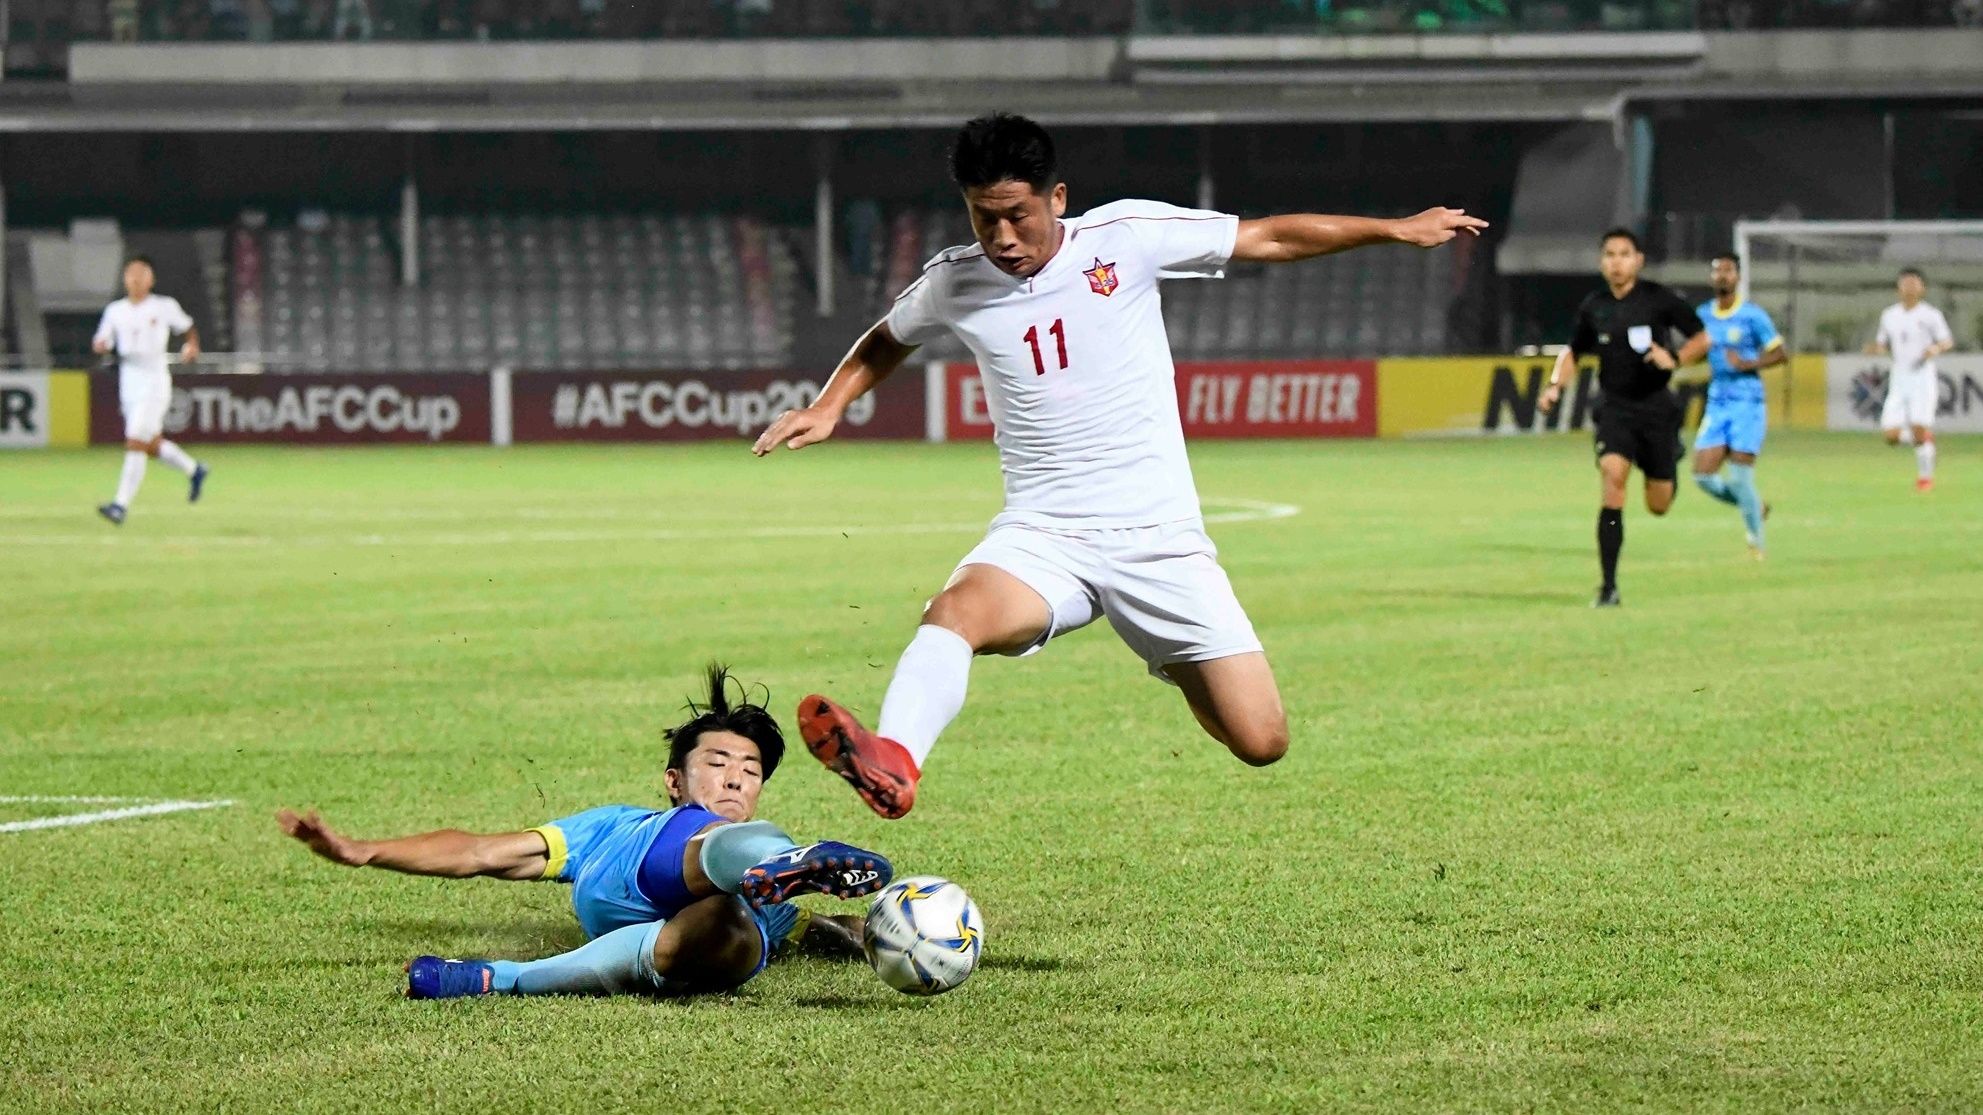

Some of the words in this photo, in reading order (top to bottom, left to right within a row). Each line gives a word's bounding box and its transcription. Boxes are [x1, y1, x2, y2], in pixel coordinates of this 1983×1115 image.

[1023, 318, 1068, 376] 11
[552, 379, 876, 434] #AFCCup209
[1187, 374, 1242, 425] FLY
[1247, 373, 1361, 425] BETTER
